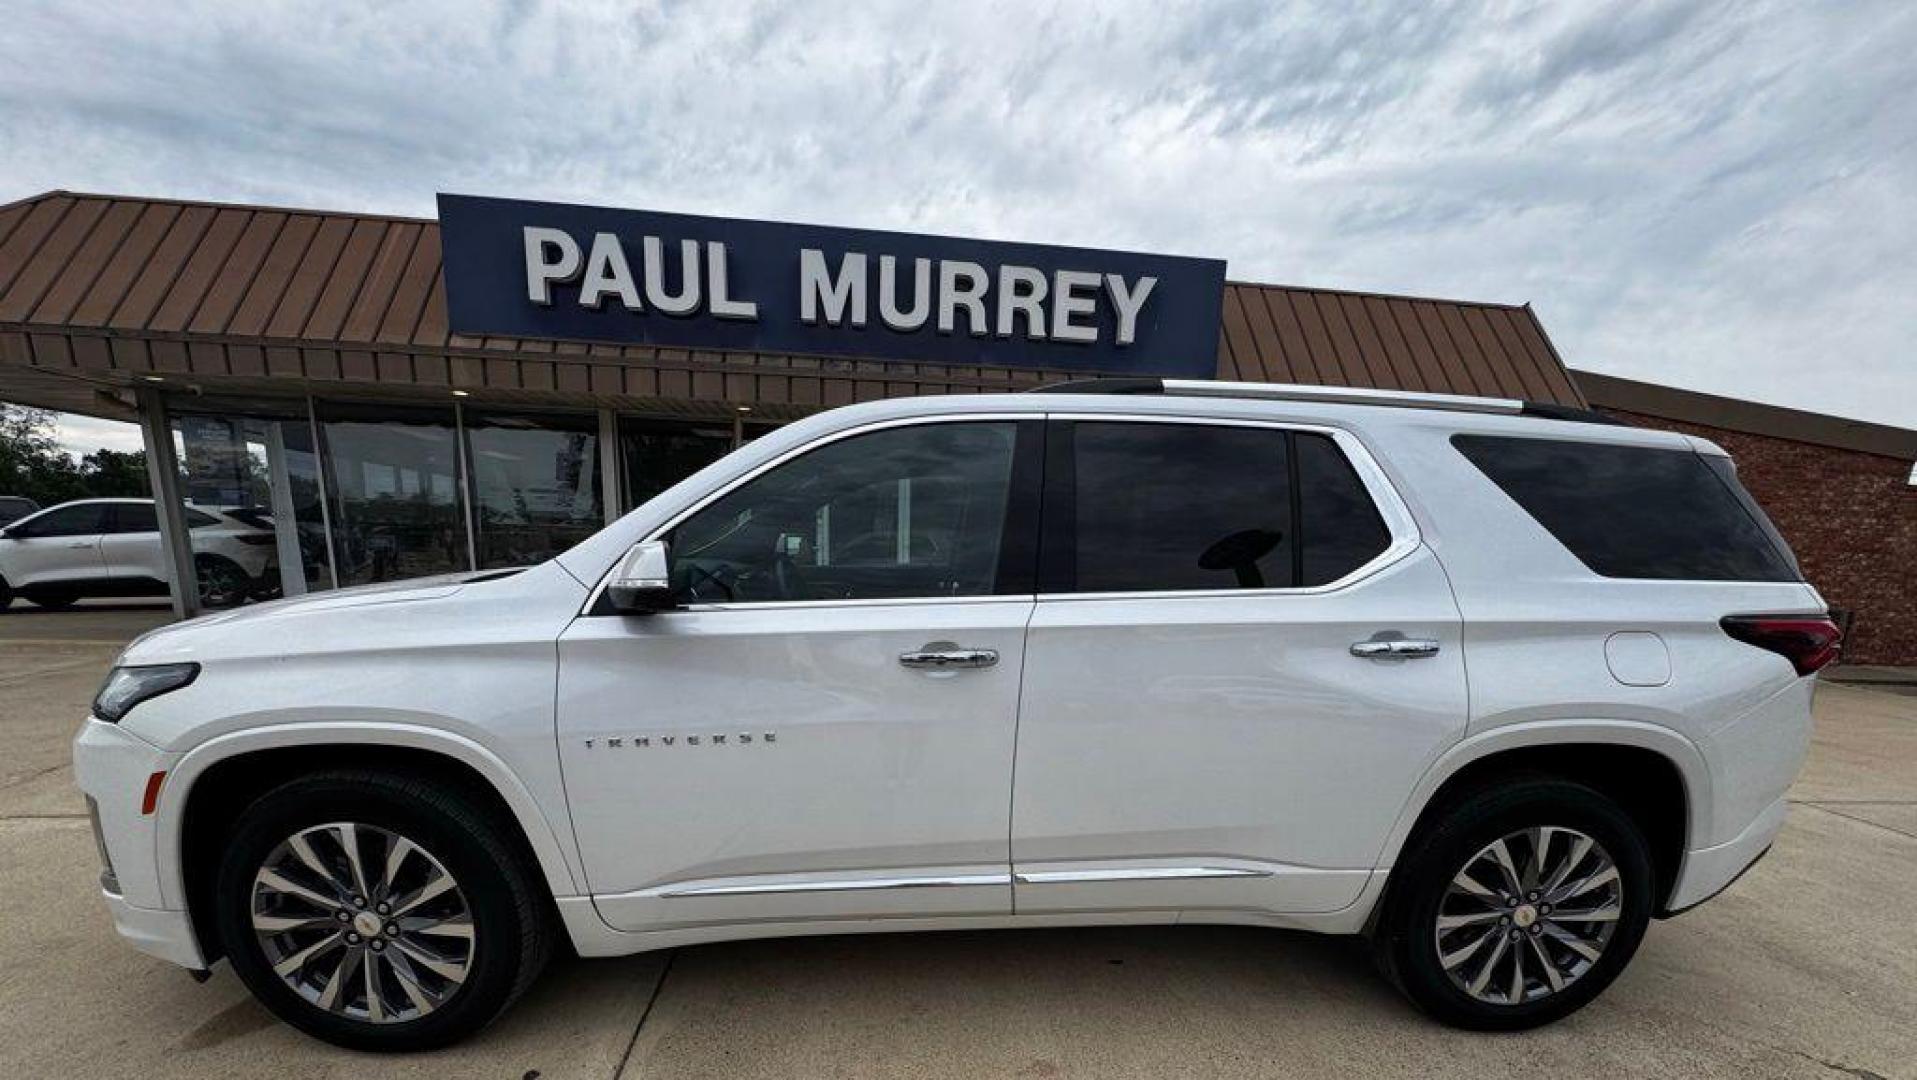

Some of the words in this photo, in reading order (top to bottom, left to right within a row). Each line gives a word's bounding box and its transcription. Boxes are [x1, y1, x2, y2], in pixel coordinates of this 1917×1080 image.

[523, 225, 758, 320] PAUL
[799, 247, 1158, 346] MURREY
[584, 730, 777, 749] TRAVERSE
